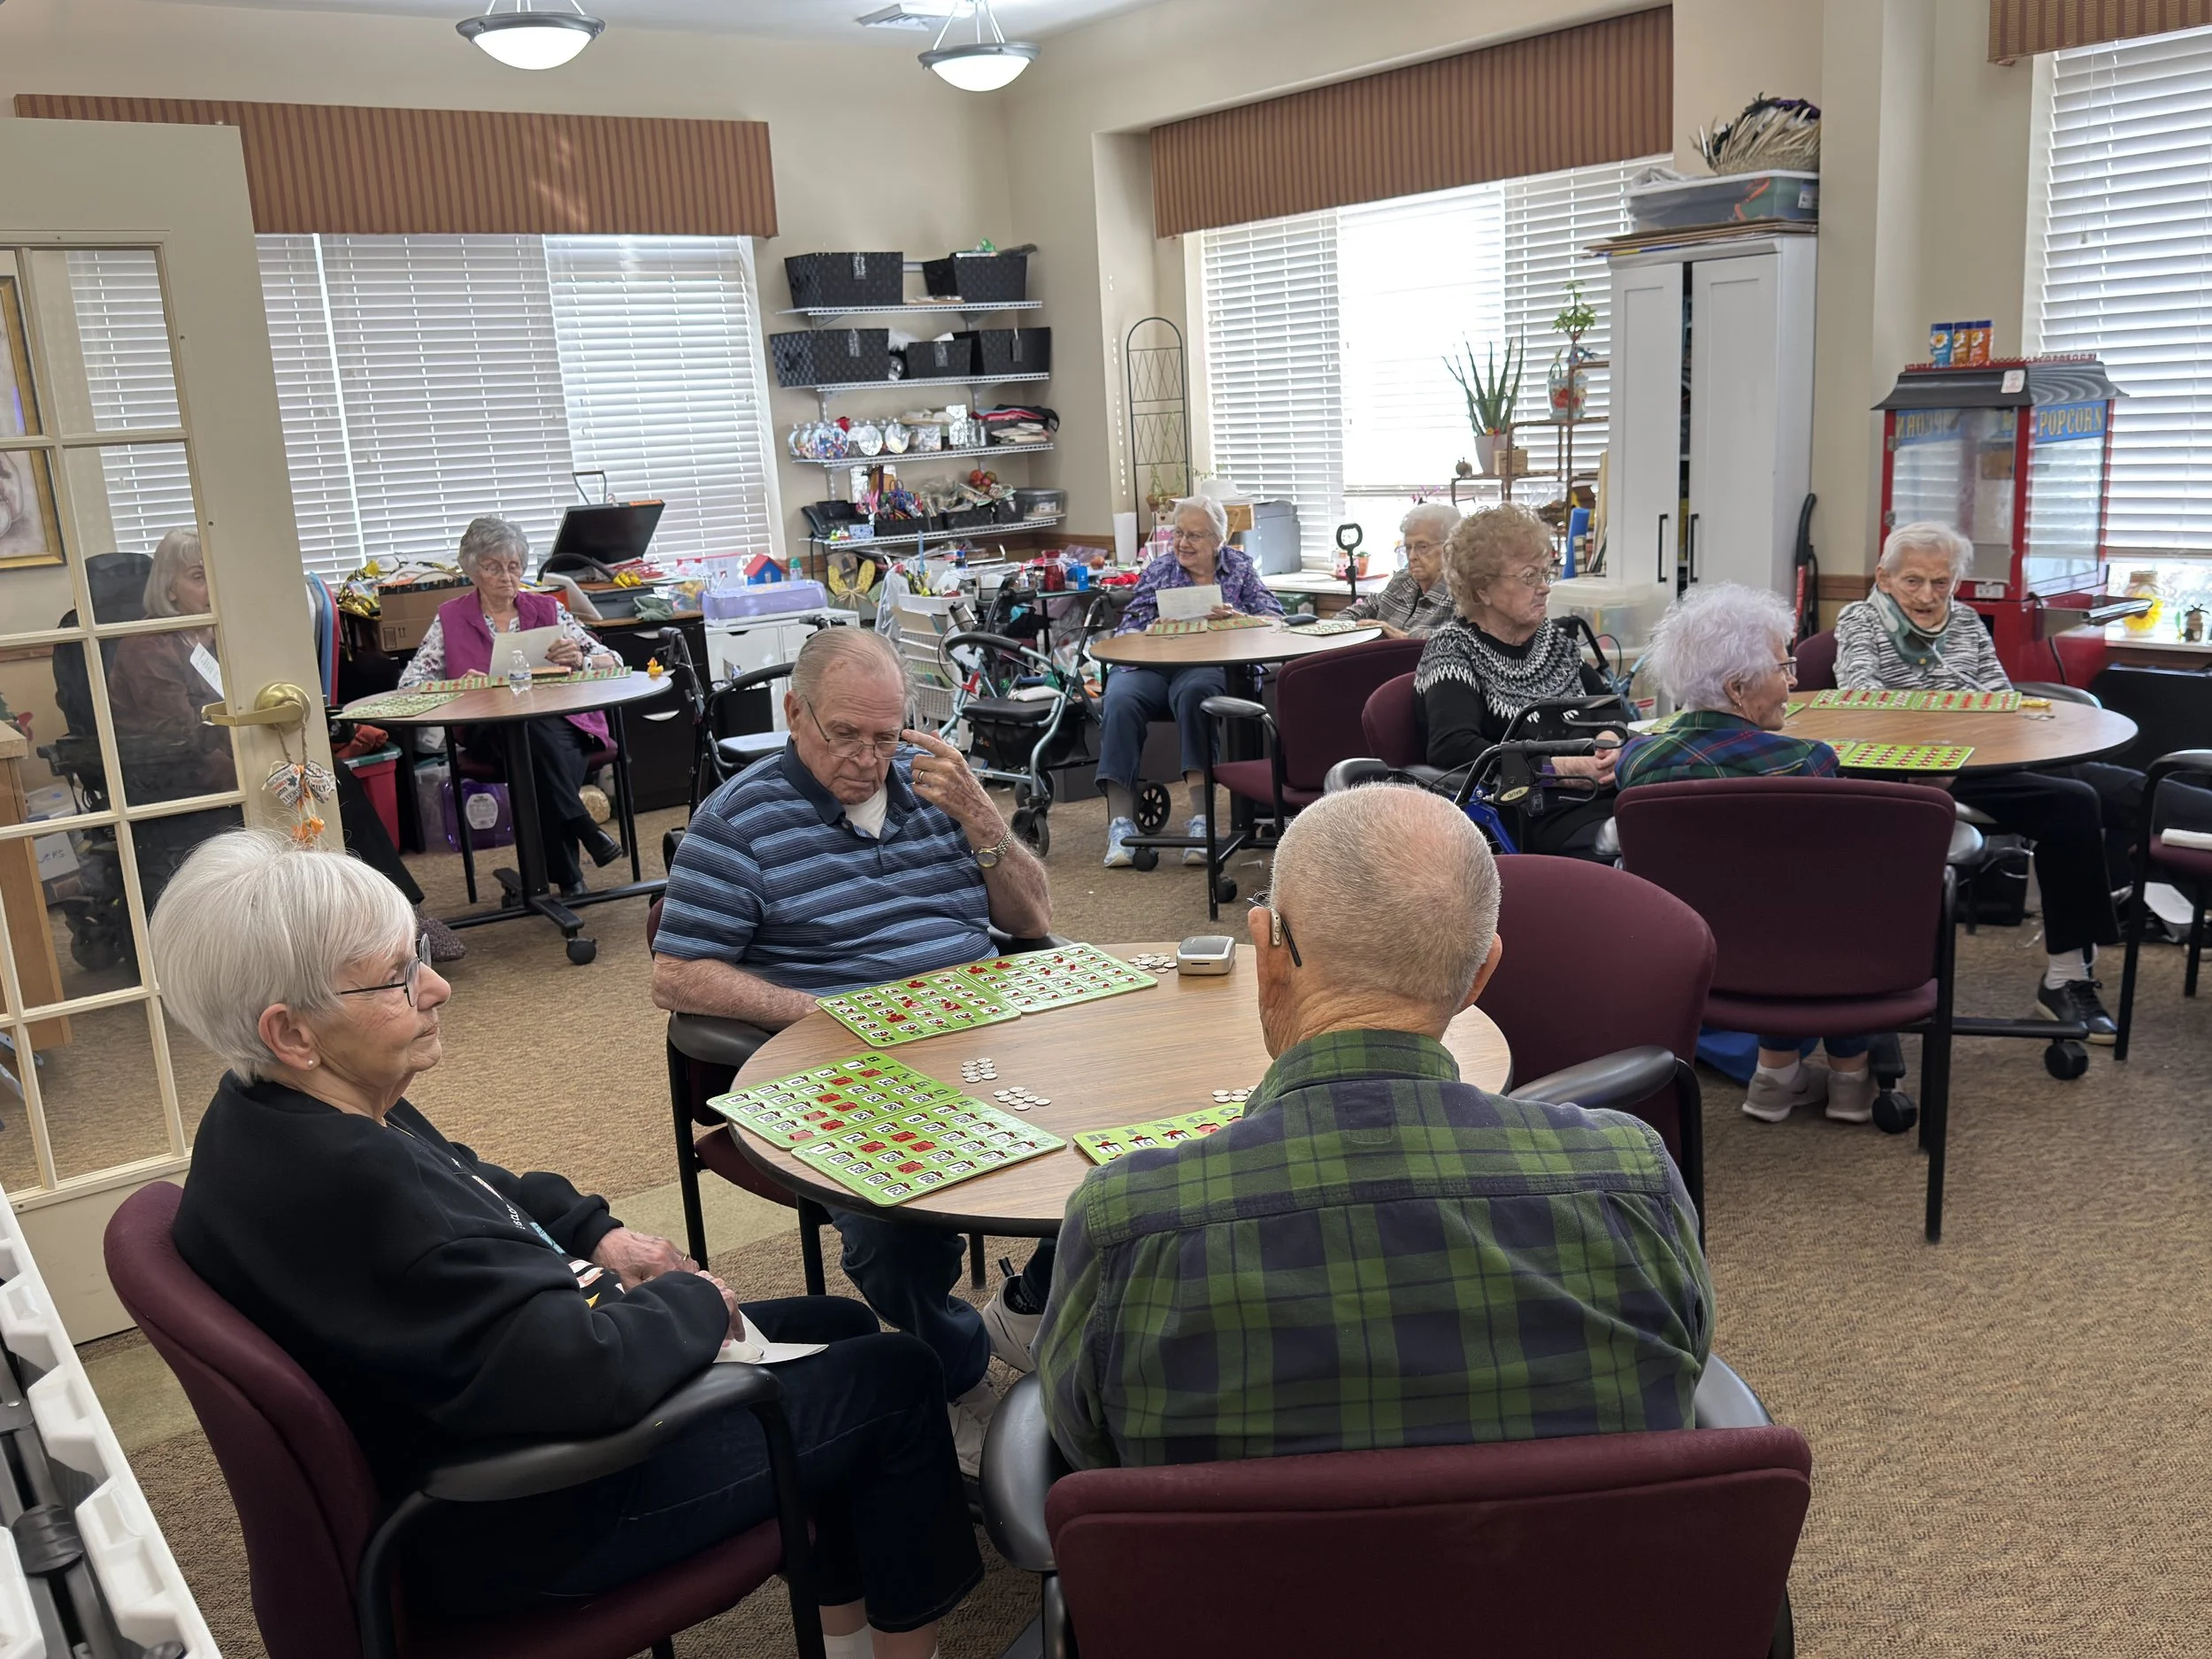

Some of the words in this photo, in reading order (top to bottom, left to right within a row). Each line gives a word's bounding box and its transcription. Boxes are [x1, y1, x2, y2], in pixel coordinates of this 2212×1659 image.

[2039, 407, 2102, 437] POPCORN
[846, 1134, 864, 1143] 14
[881, 1153, 901, 1163] 35
[919, 1174, 940, 1184] 66
[877, 1125, 895, 1133] 15
[932, 1153, 951, 1163] 52
[952, 1163, 972, 1173] 73
[943, 1133, 963, 1142] 32
[963, 1143, 982, 1152] 59
[831, 1155, 851, 1164] 20
[849, 1164, 869, 1174] 39
[868, 1175, 888, 1185] 60
[887, 1186, 908, 1196] 63
